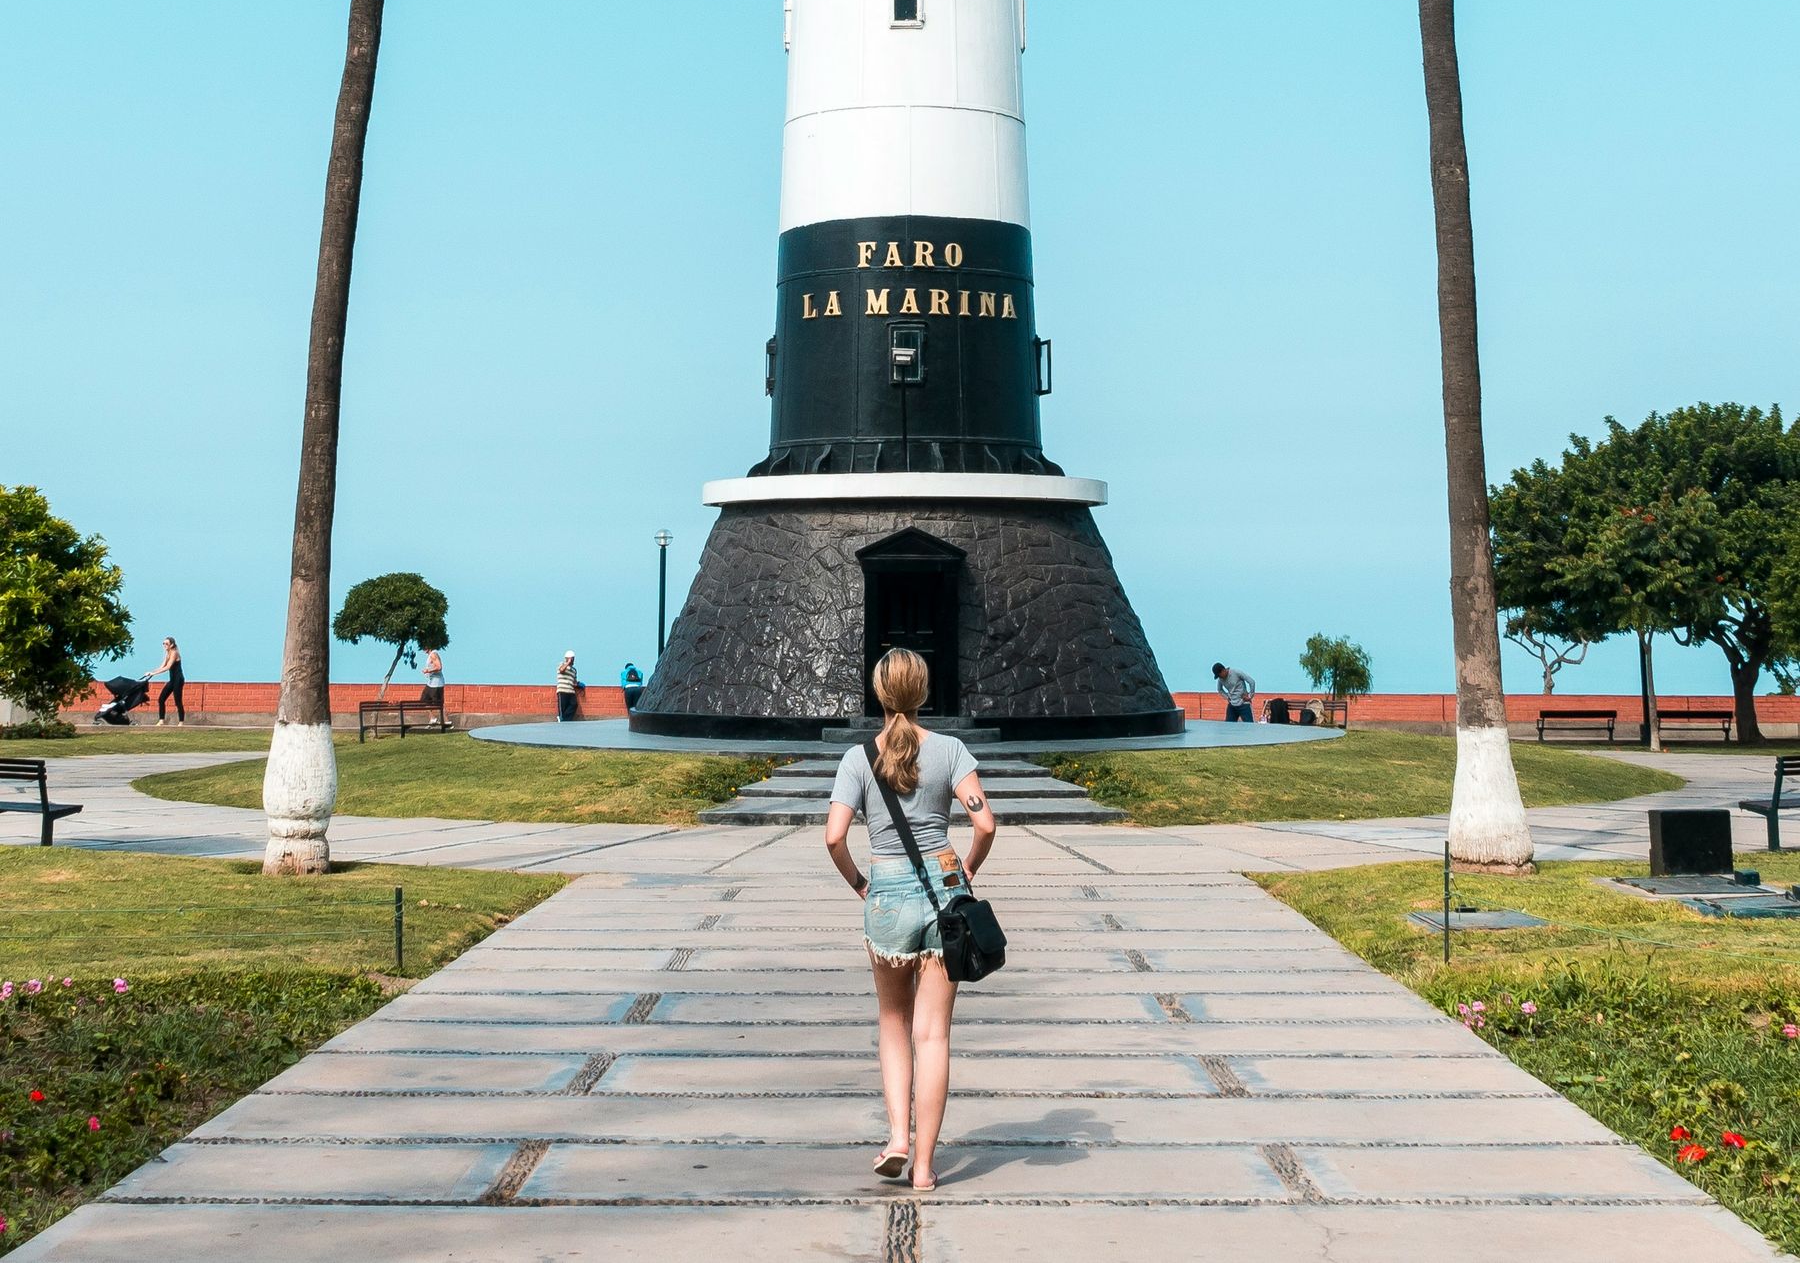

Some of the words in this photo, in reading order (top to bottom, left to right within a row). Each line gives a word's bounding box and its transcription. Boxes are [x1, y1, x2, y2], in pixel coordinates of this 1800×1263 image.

[857, 241, 963, 268] FARO
[802, 290, 842, 319] LA
[865, 288, 1018, 319] MARINA
